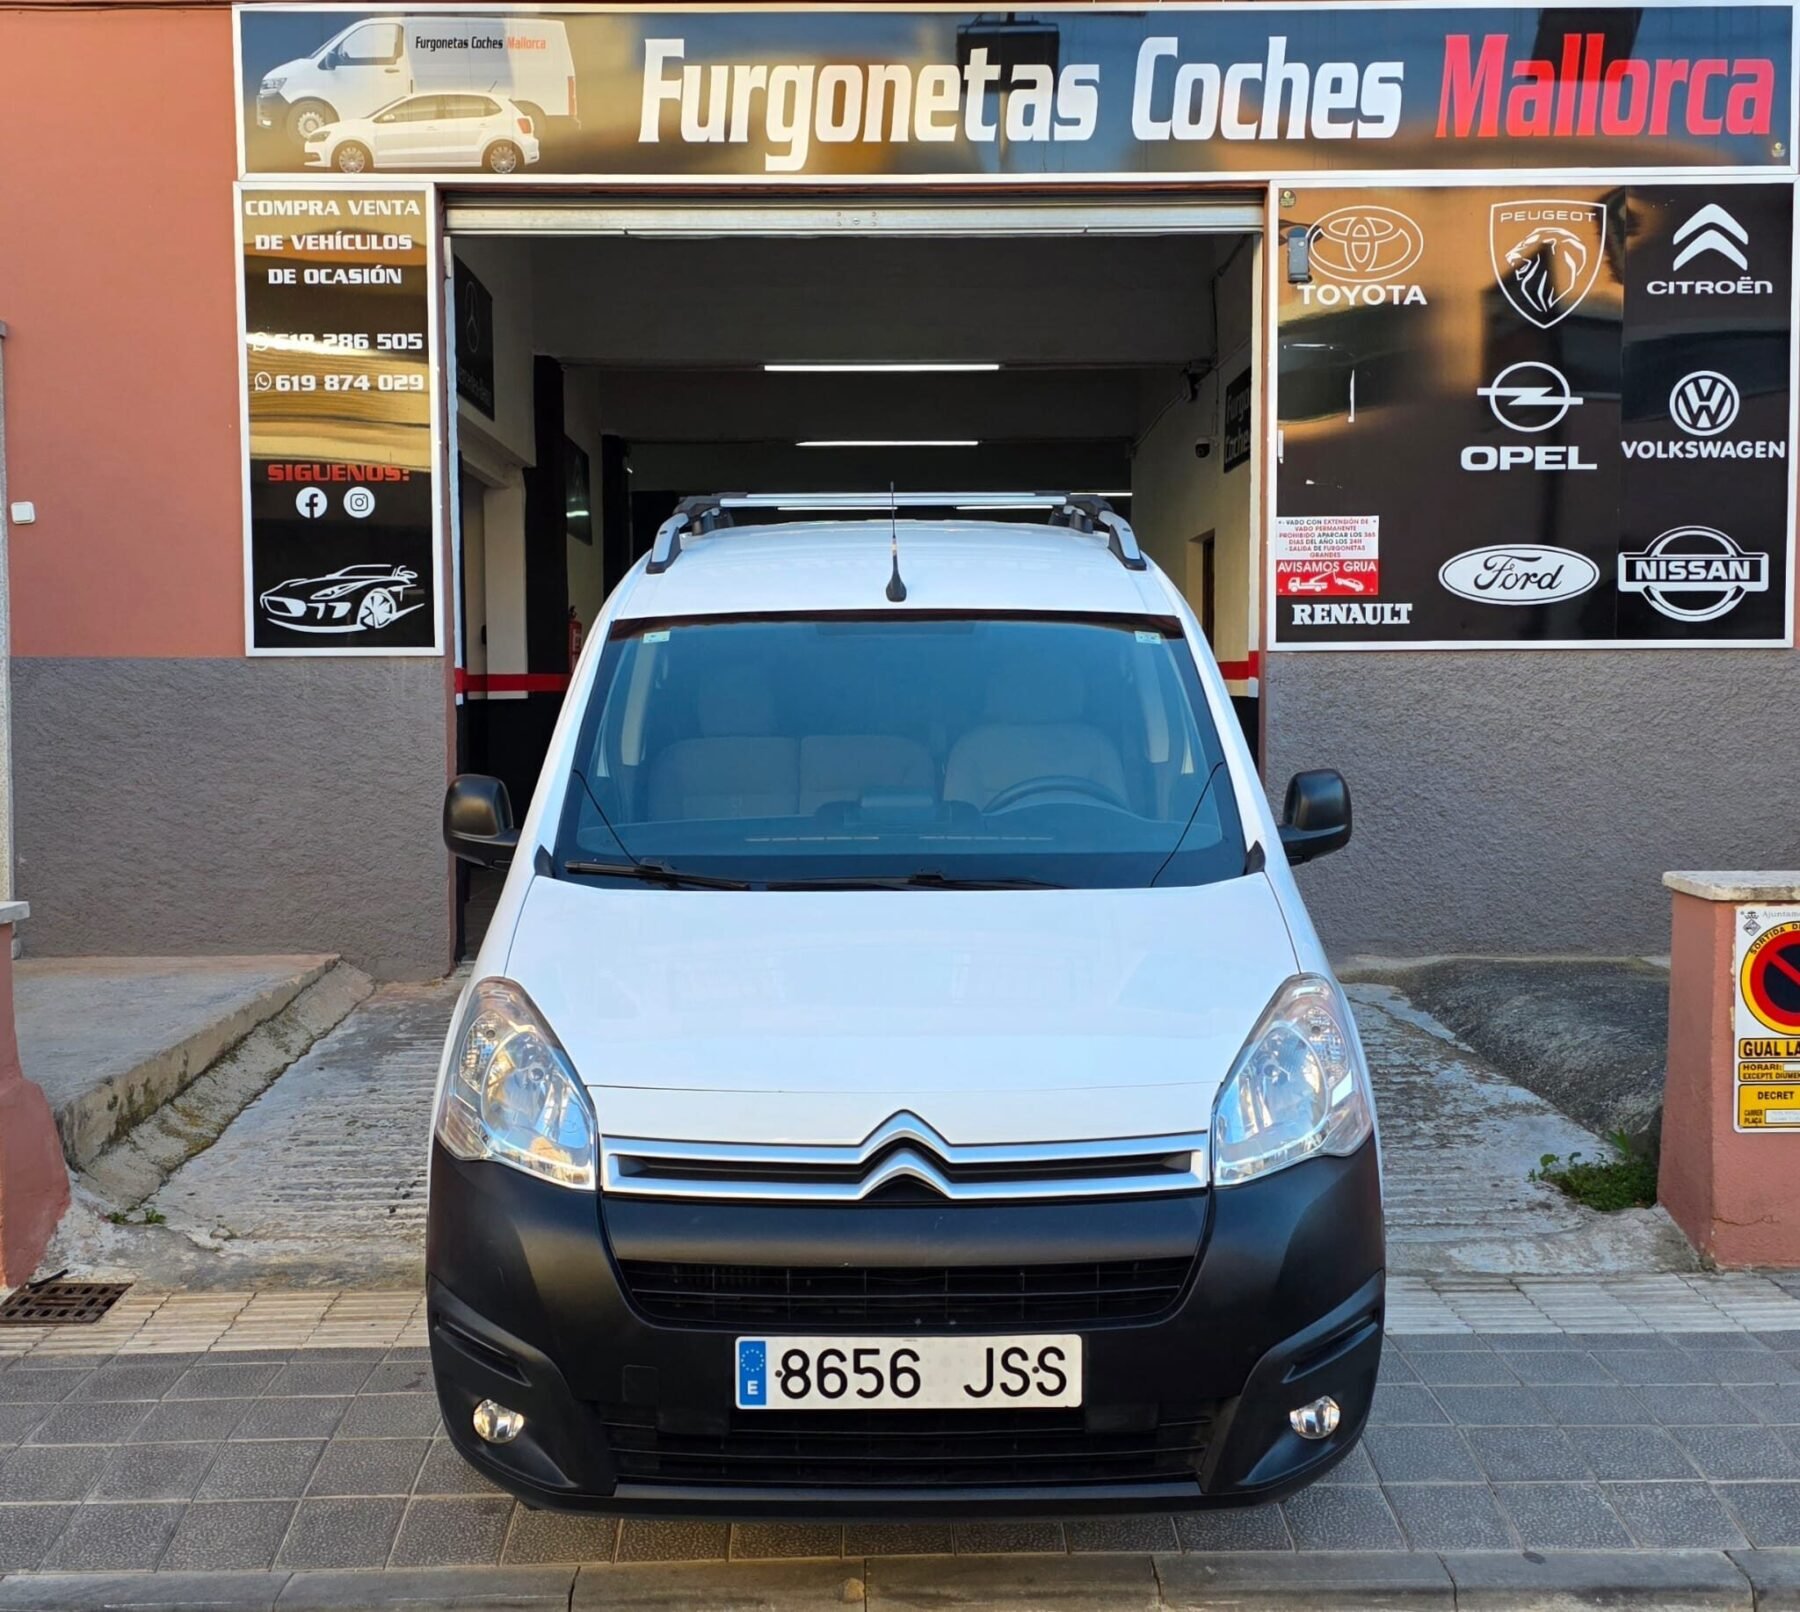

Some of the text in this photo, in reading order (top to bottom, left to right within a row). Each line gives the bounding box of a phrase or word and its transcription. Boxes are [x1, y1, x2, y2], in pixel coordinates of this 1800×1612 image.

[415, 36, 546, 52] Furgonetas Coches Mallorca
[638, 33, 1775, 171] Furgonetas Coches Mallorca
[245, 199, 421, 216] COMPRA VENTA
[1500, 210, 1597, 223] PEUGEOT
[255, 231, 412, 251] DE VEHÍCULOS
[268, 265, 402, 285] DE OCASIÓN
[1297, 284, 1427, 305] TOYOTA
[322, 333, 369, 350] 286
[377, 333, 423, 349] 505
[275, 374, 424, 391] 619 874 029
[1460, 446, 1597, 471] OPEL
[1621, 440, 1786, 459] VOLKSWAGEN
[1277, 561, 1377, 573] AVISAMOS GRUA
[1473, 554, 1565, 591] Ford
[1635, 560, 1750, 580] NISSAN
[1292, 603, 1413, 625] RENAULT
[1750, 926, 1786, 955] SORTIDA
[1743, 1041, 1781, 1056] GUAL
[1743, 1072, 1773, 1080] EXCEPTE
[1757, 1091, 1794, 1100] DECRET
[780, 1346, 1067, 1399] 8656 JSS
[747, 1380, 758, 1395] E
